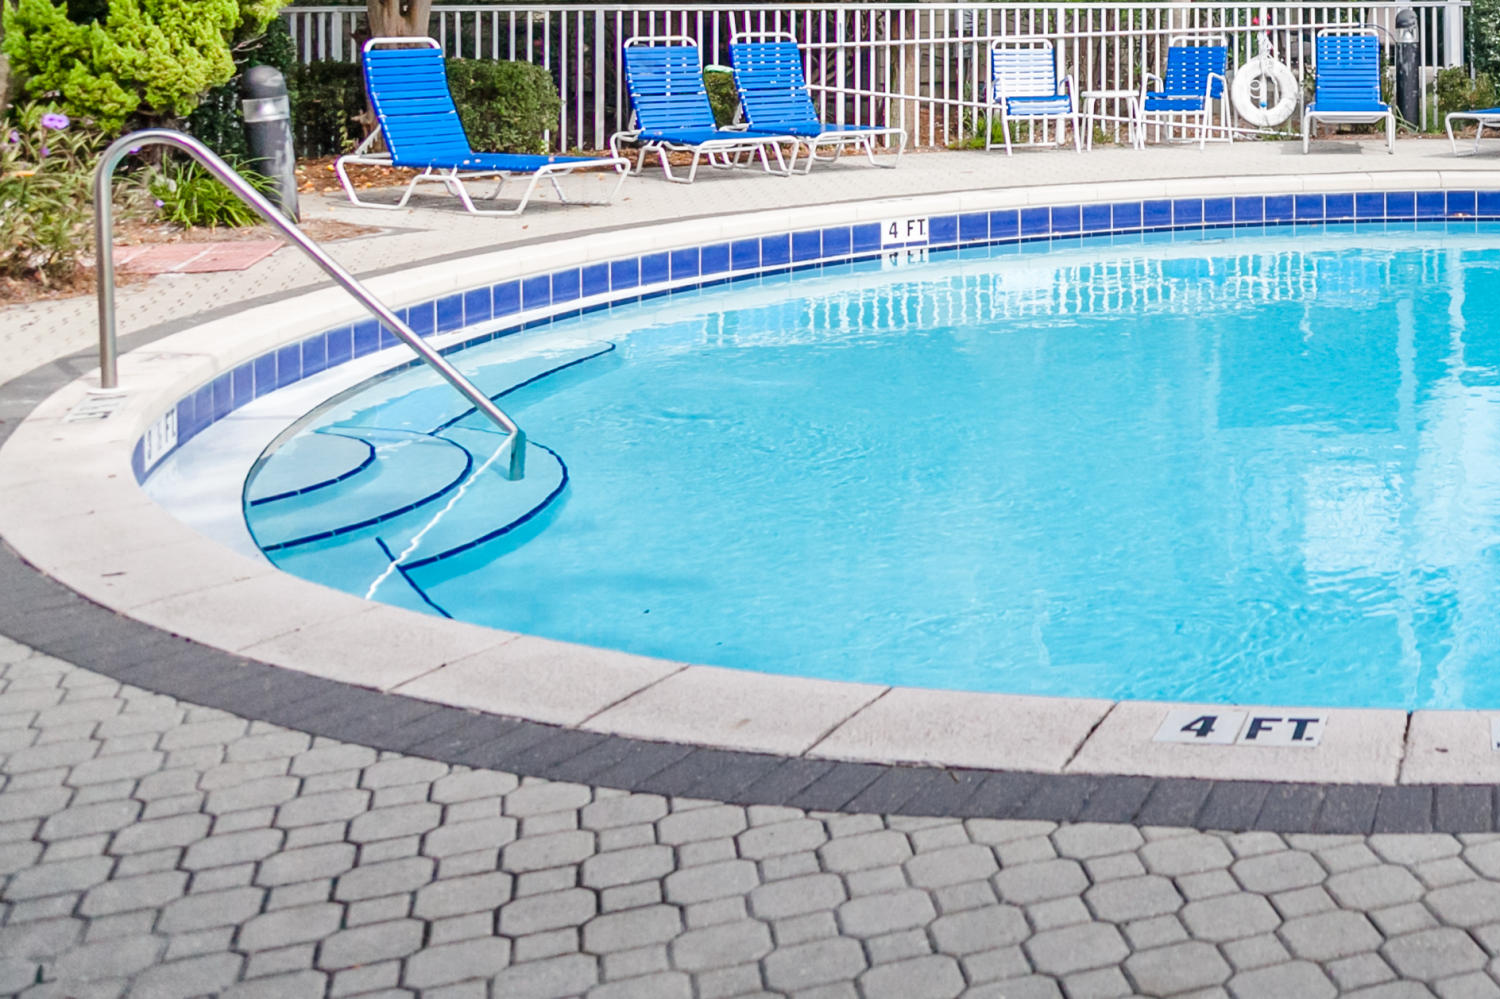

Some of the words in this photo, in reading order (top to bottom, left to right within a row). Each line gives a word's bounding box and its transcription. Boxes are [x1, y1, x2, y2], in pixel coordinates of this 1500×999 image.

[888, 221, 899, 239] 4
[1180, 714, 1219, 738] 4
[1244, 717, 1320, 742] FT.
